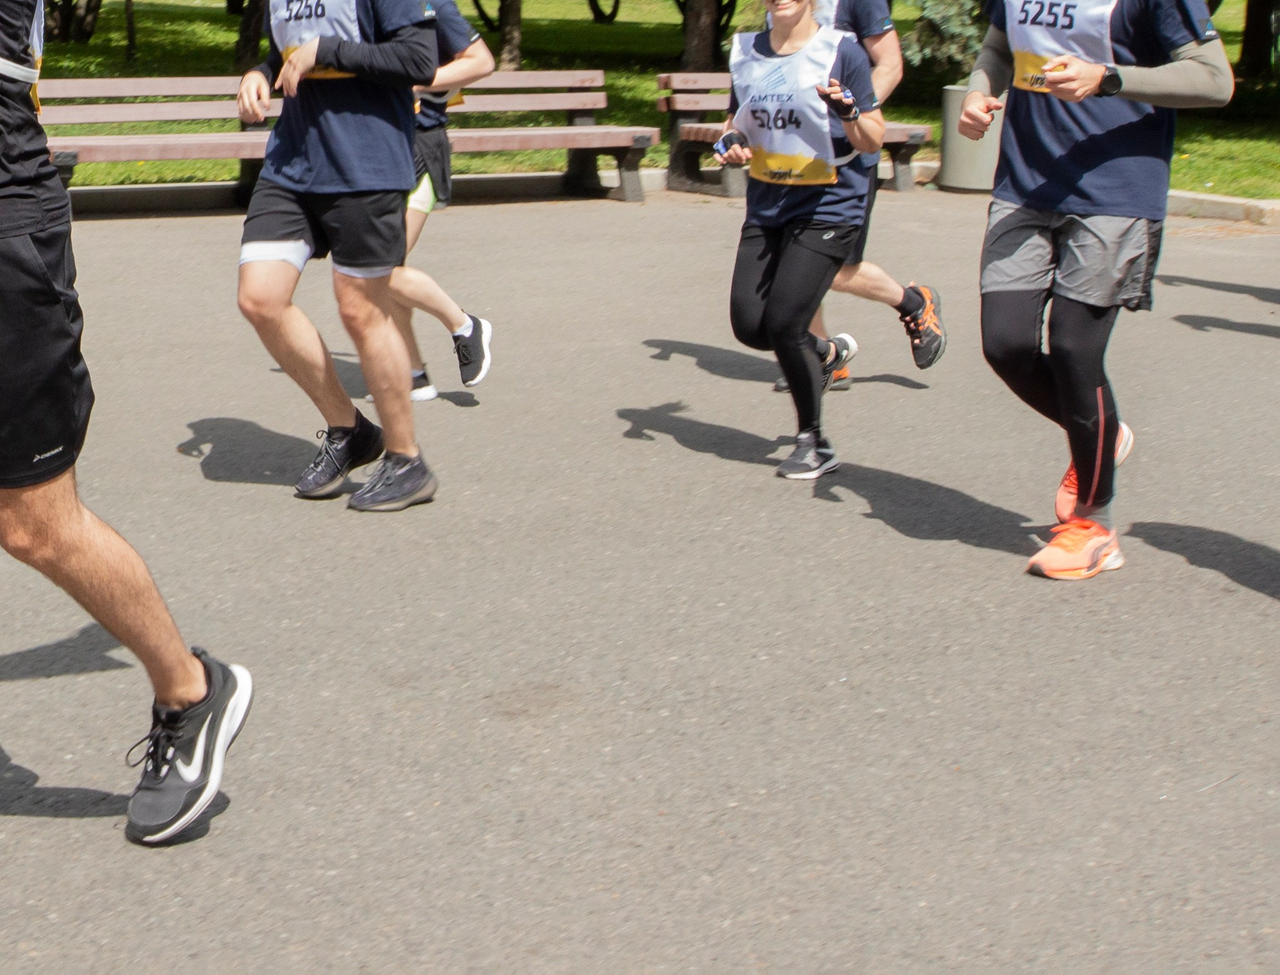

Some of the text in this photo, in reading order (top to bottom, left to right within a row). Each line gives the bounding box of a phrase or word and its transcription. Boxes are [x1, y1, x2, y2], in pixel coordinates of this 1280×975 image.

[1018, 0, 1078, 30] 5255
[750, 94, 793, 103] AMTEX
[751, 109, 801, 130] 5264
